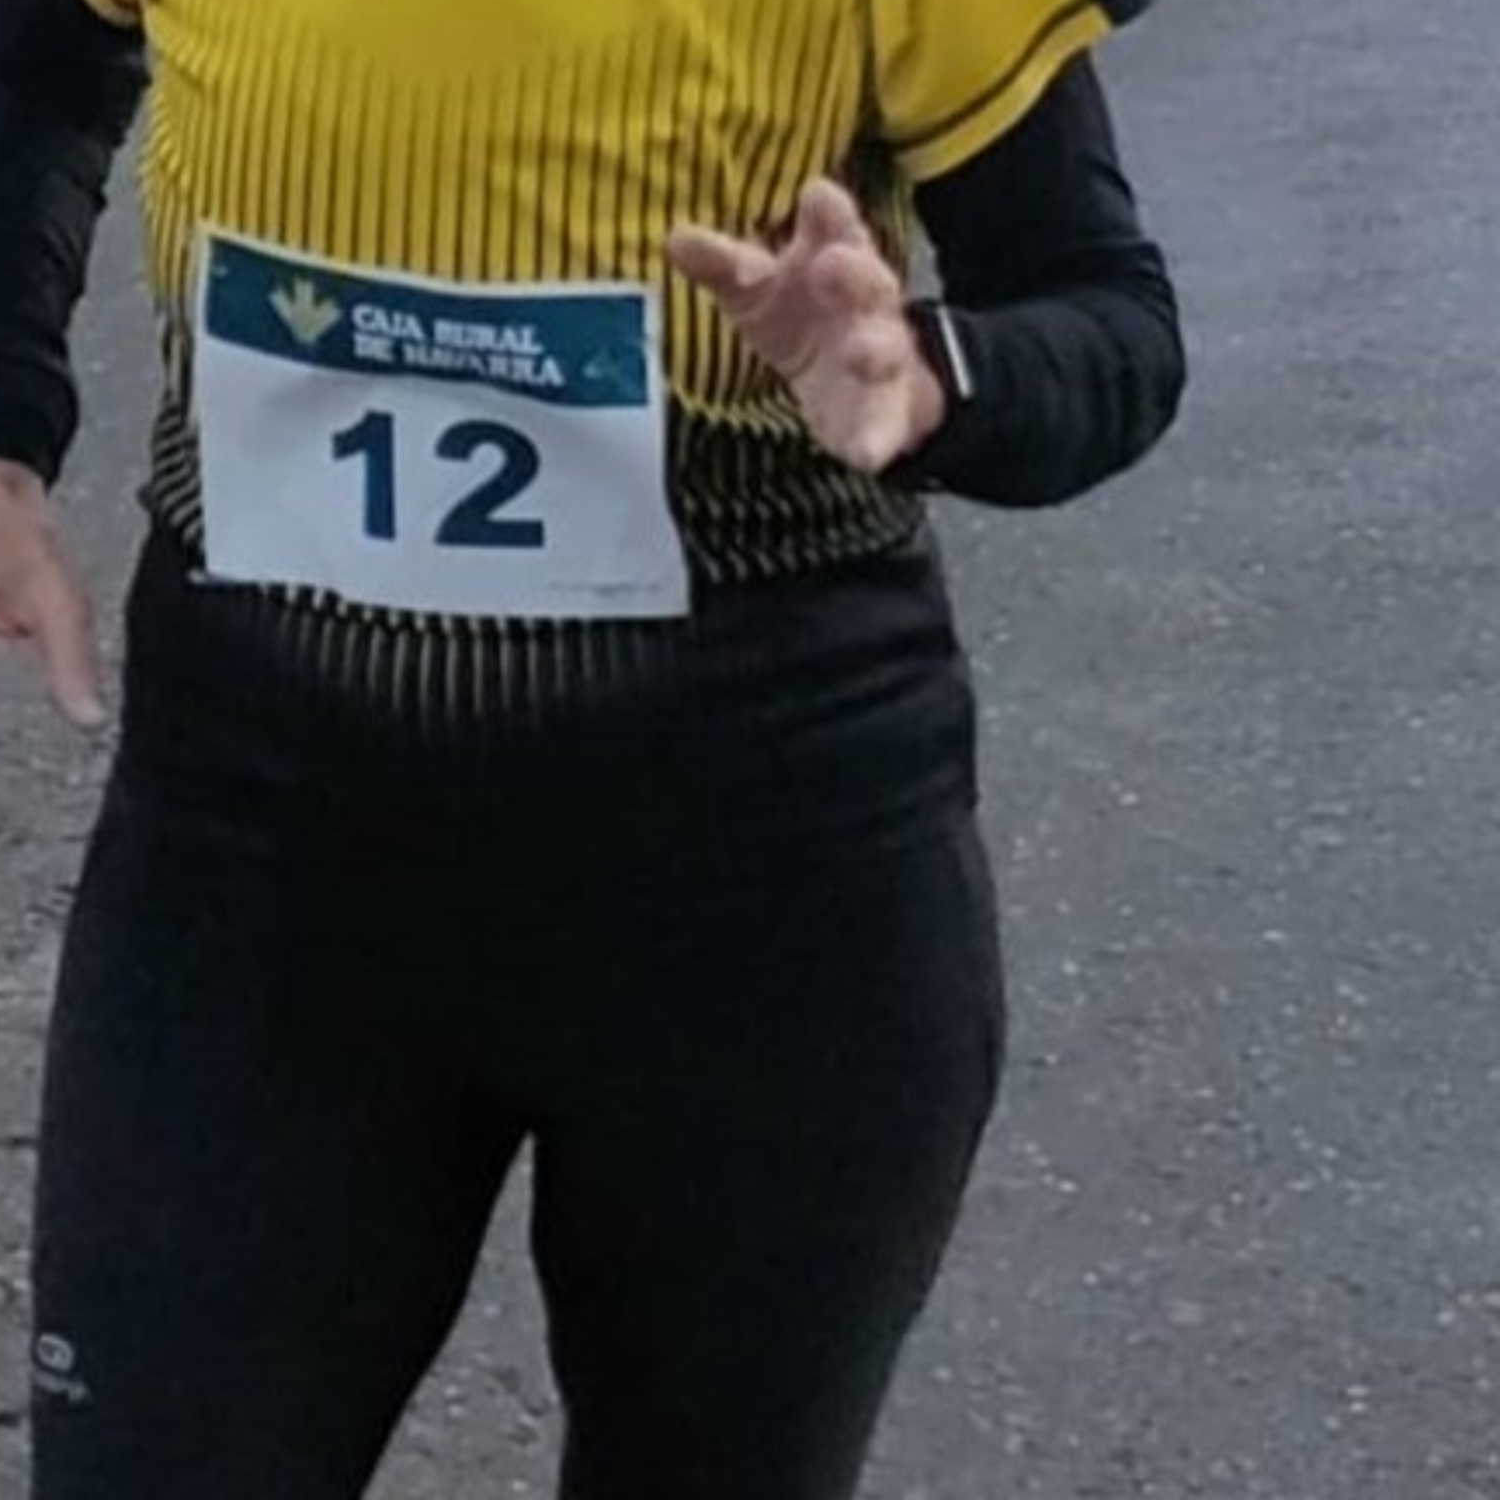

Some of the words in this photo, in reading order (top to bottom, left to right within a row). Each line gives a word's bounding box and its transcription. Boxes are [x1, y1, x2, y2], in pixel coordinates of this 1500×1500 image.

[352, 304, 425, 339] CAJA
[433, 318, 543, 355] RURAL
[353, 333, 393, 361] DE
[331, 411, 545, 548] 12
